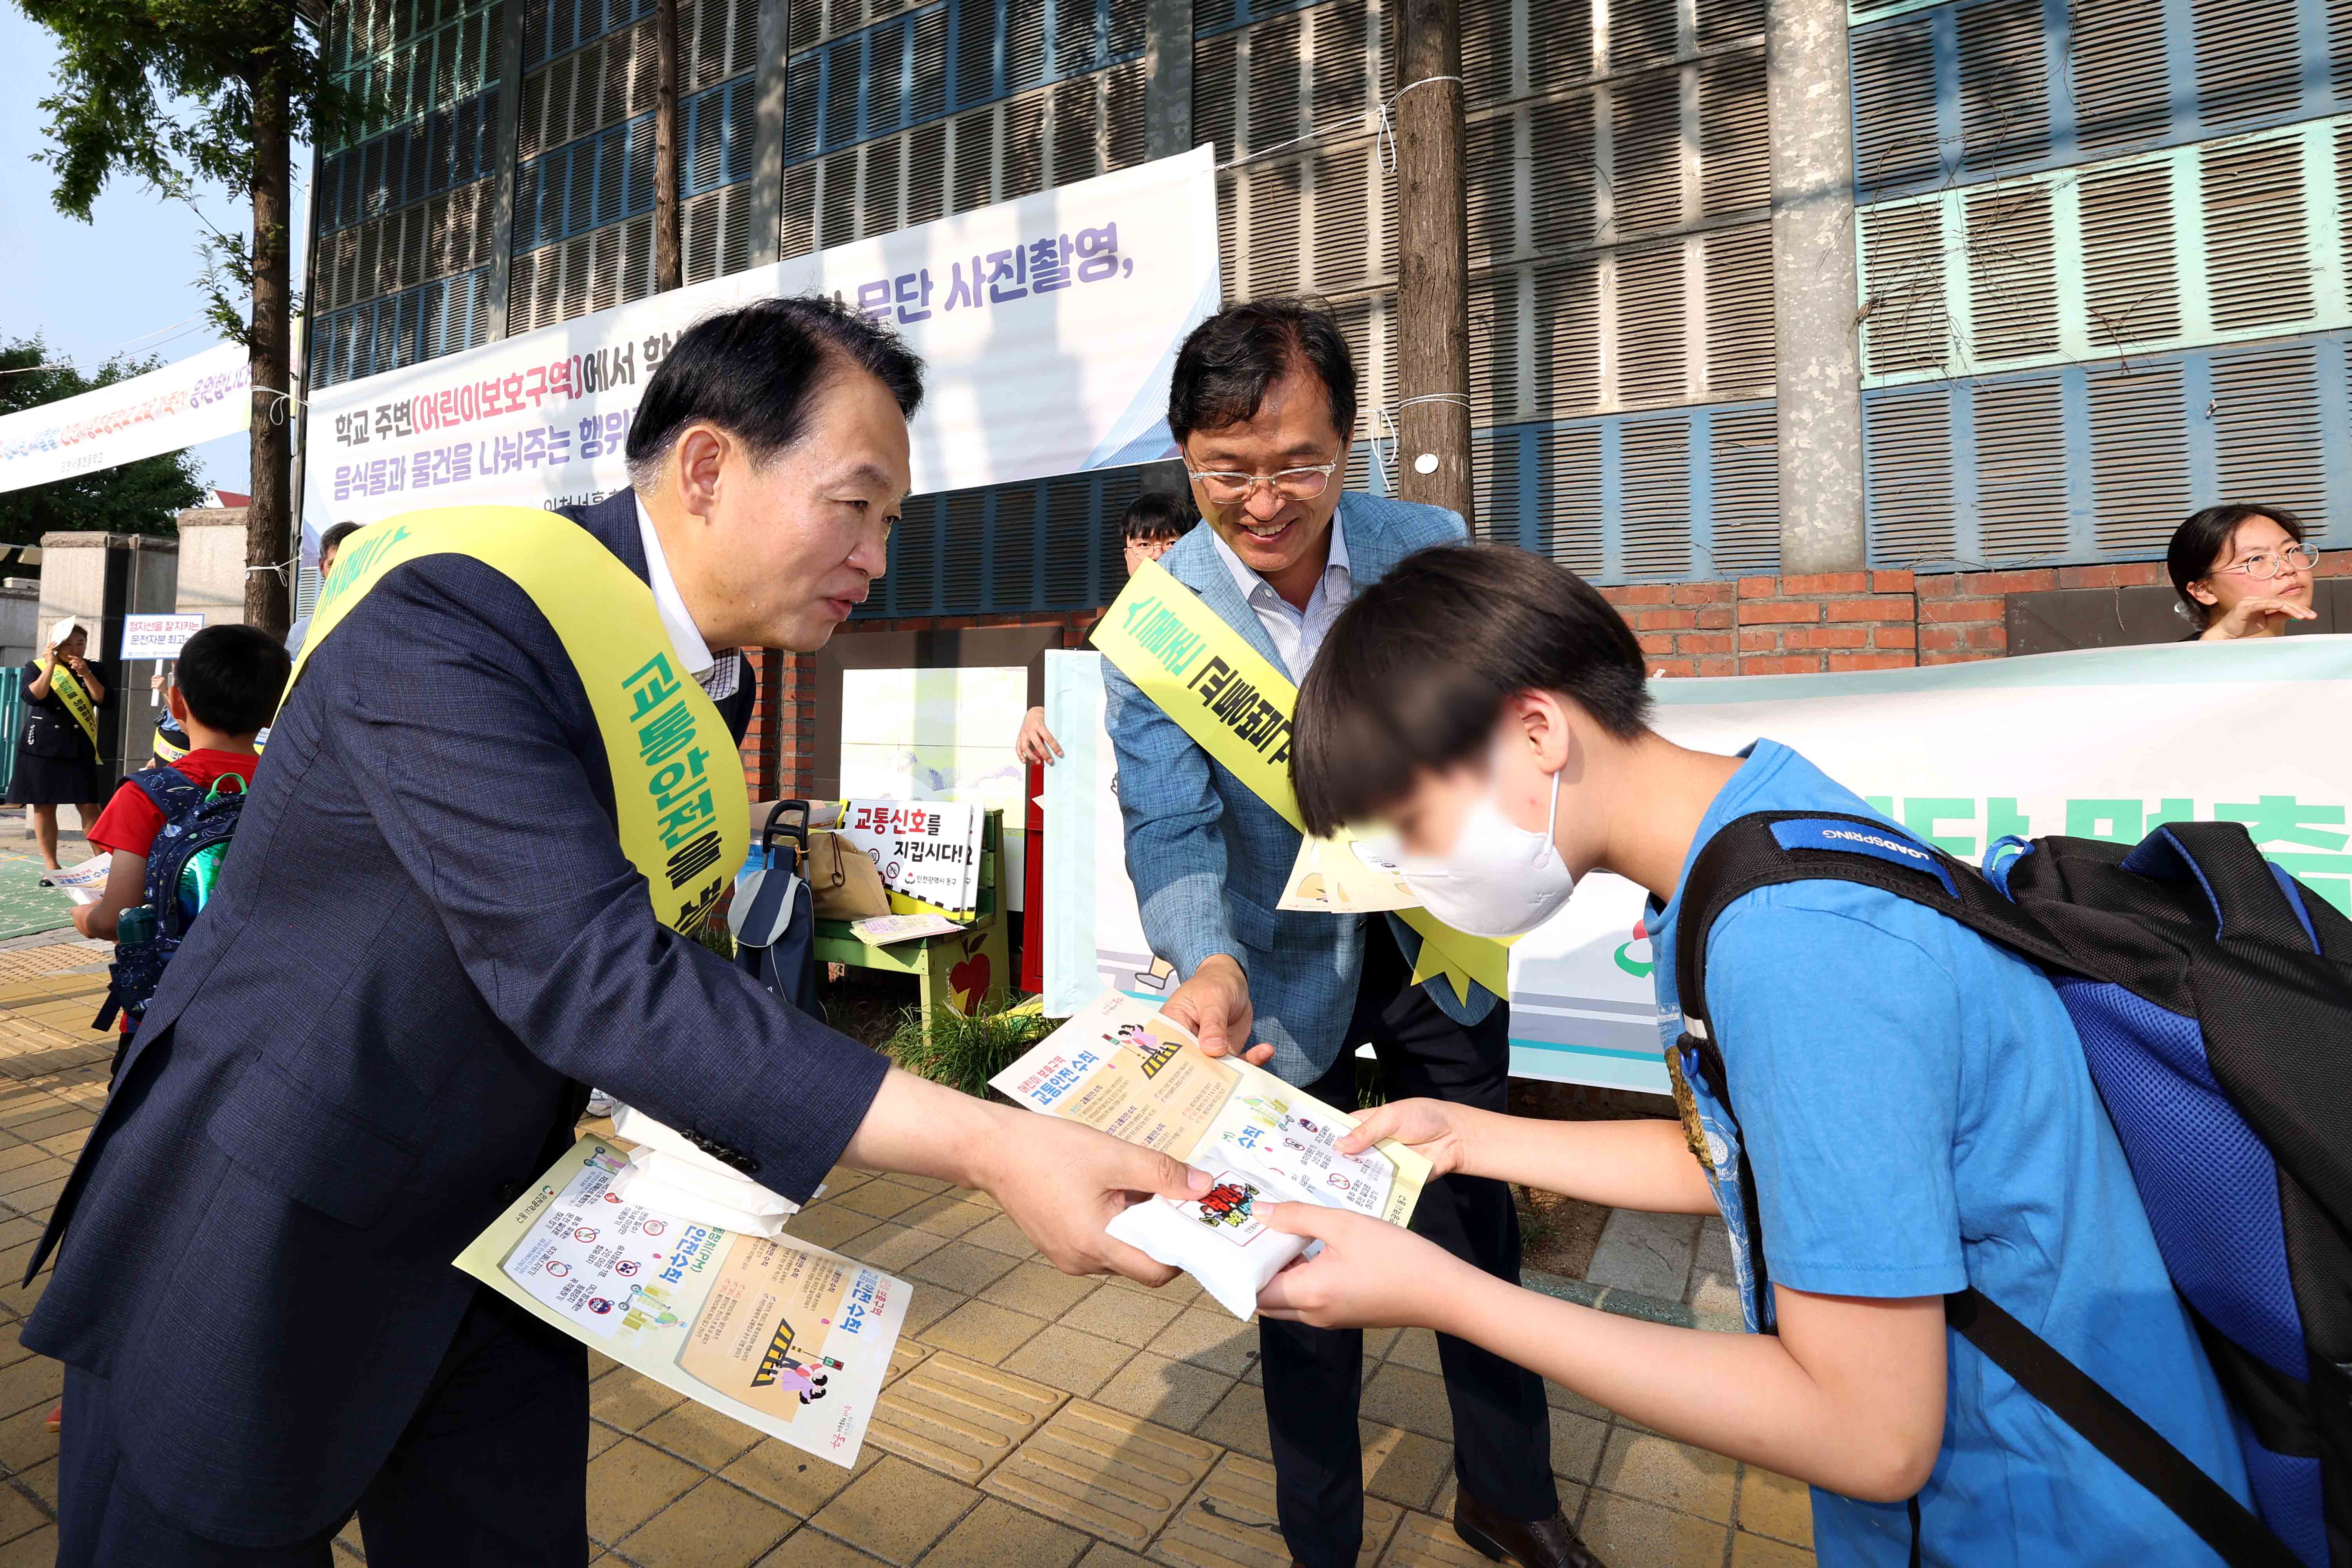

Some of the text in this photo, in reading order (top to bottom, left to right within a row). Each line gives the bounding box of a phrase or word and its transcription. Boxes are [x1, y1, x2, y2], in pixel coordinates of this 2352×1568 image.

[857, 221, 1133, 324] 무단 사진촬영,
[335, 407, 369, 447] 학교
[334, 407, 637, 501] 음식물과 물건을 나눠주는 행위
[129, 621, 199, 632] 정지선을 잘 지키는
[1123, 595, 1207, 676] 스쿨존
[131, 635, 166, 645] 운전자분
[622, 652, 722, 890] 교통안전을
[855, 807, 941, 836] 교통신호를
[894, 841, 963, 864] 지킵시다!
[1822, 829, 1930, 860] LOADSPRING
[917, 875, 945, 884] 인천광역시
[1018, 1056, 1065, 1093] 어린이 보호구역
[1032, 1068, 1079, 1104] 교통안전
[1072, 1051, 1099, 1071] 수칙
[1080, 1091, 1096, 1105] 교통안전
[1114, 1112, 1131, 1126] 교통안전
[1128, 1106, 1138, 1114] 수칙
[1144, 1130, 1160, 1144] 교통안전
[1156, 1123, 1166, 1131] 수칙
[587, 1183, 603, 1194] 우측으로
[516, 1193, 547, 1223] 인천광역시 동구
[575, 1194, 591, 1207] 통행하기
[545, 1212, 564, 1229] 하지 않기
[552, 1212, 574, 1236] 운전 절대로
[614, 1207, 631, 1225] 이용하기
[628, 1210, 640, 1220] 16세
[630, 1212, 649, 1233] 면허 필수!
[1389, 1203, 1404, 1225] 천광역시
[559, 1216, 583, 1239] 음주 후에는
[618, 1220, 632, 1235] 이상만
[527, 1246, 557, 1276] 주차 매너 지키기
[586, 1245, 604, 1264] 탑승 금지
[594, 1249, 612, 1268] 2인 이상
[604, 1245, 624, 1269] 승차정원은
[760, 1256, 770, 1267] 수칙
[791, 1268, 800, 1278] 수칙
[556, 1283, 574, 1301] 작동하기
[567, 1285, 585, 1303] 등화장치
[572, 1284, 597, 1311] 야간 밤길에는
[828, 1283, 836, 1293] 수칙
[840, 1269, 877, 1333] 교통안전 수칙
[871, 1290, 887, 1316] 보호구역
